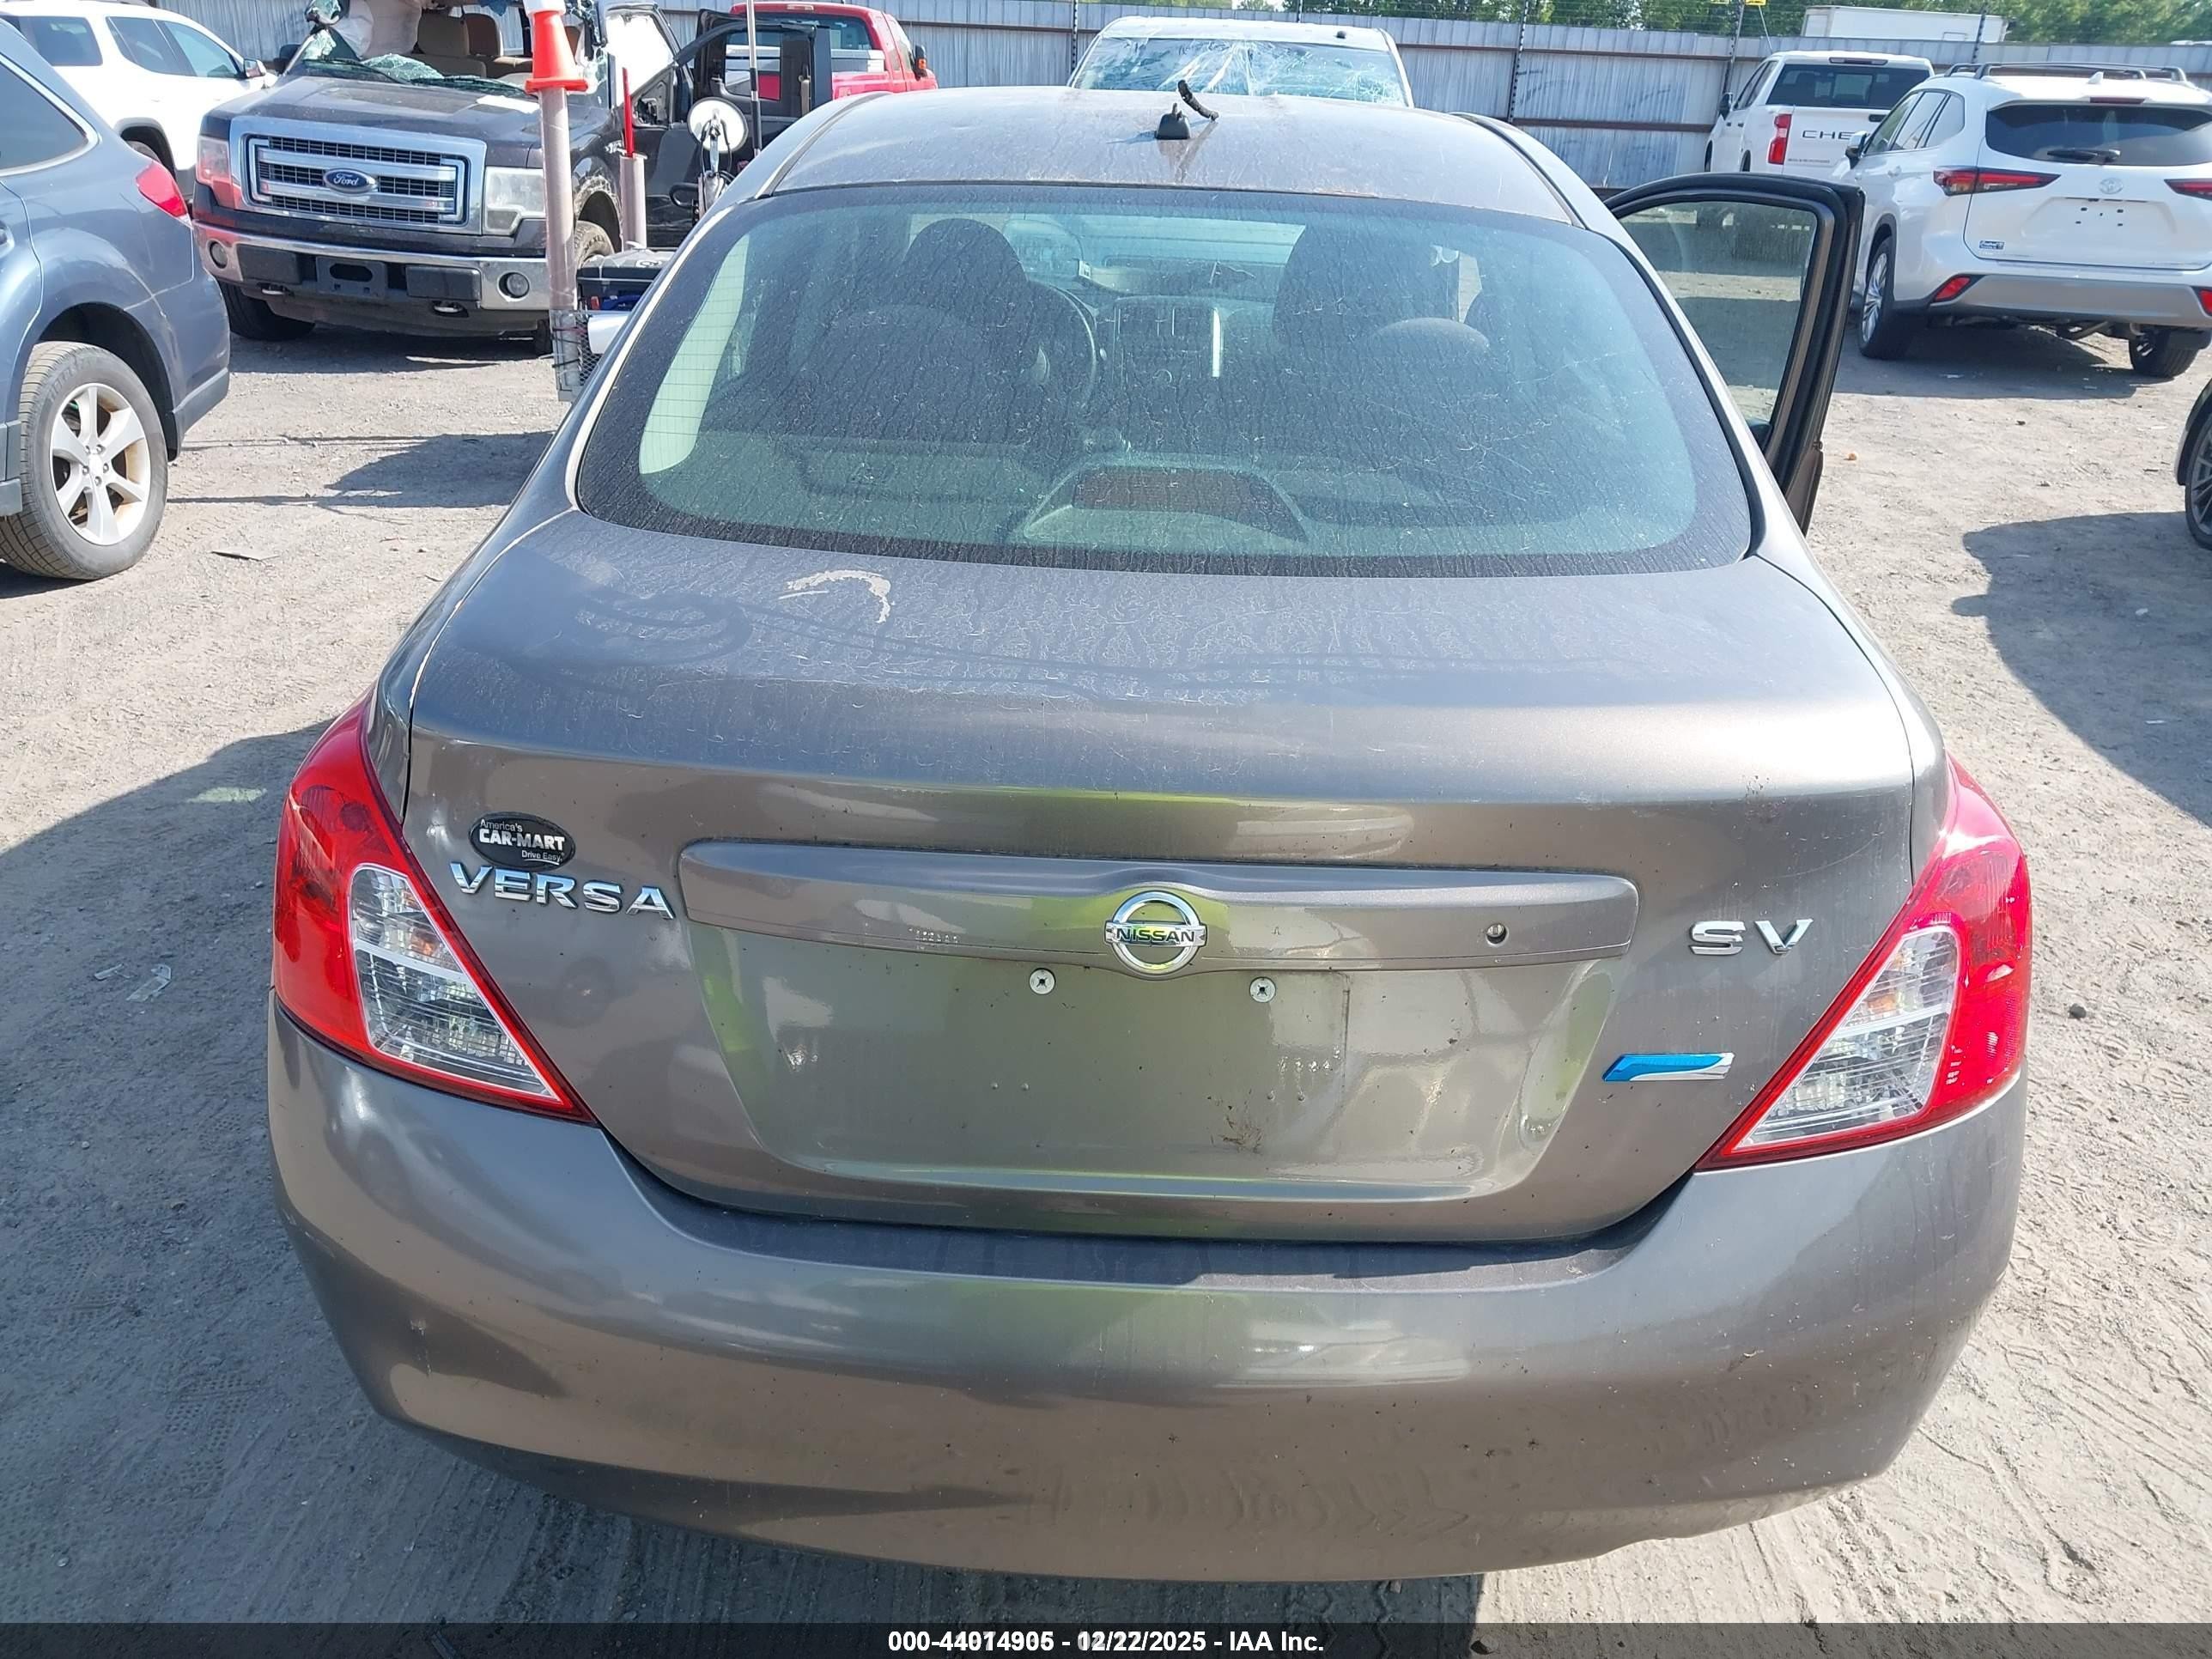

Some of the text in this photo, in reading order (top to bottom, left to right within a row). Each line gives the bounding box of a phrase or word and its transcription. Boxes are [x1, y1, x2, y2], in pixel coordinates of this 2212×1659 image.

[333, 172, 359, 186] Ford
[480, 818, 523, 832] America's
[479, 828, 565, 851] CAR-MART
[521, 850, 541, 860] Drive
[449, 861, 676, 920] VERSA
[1115, 927, 1195, 943] NISSAN
[1689, 919, 1814, 955] SV
